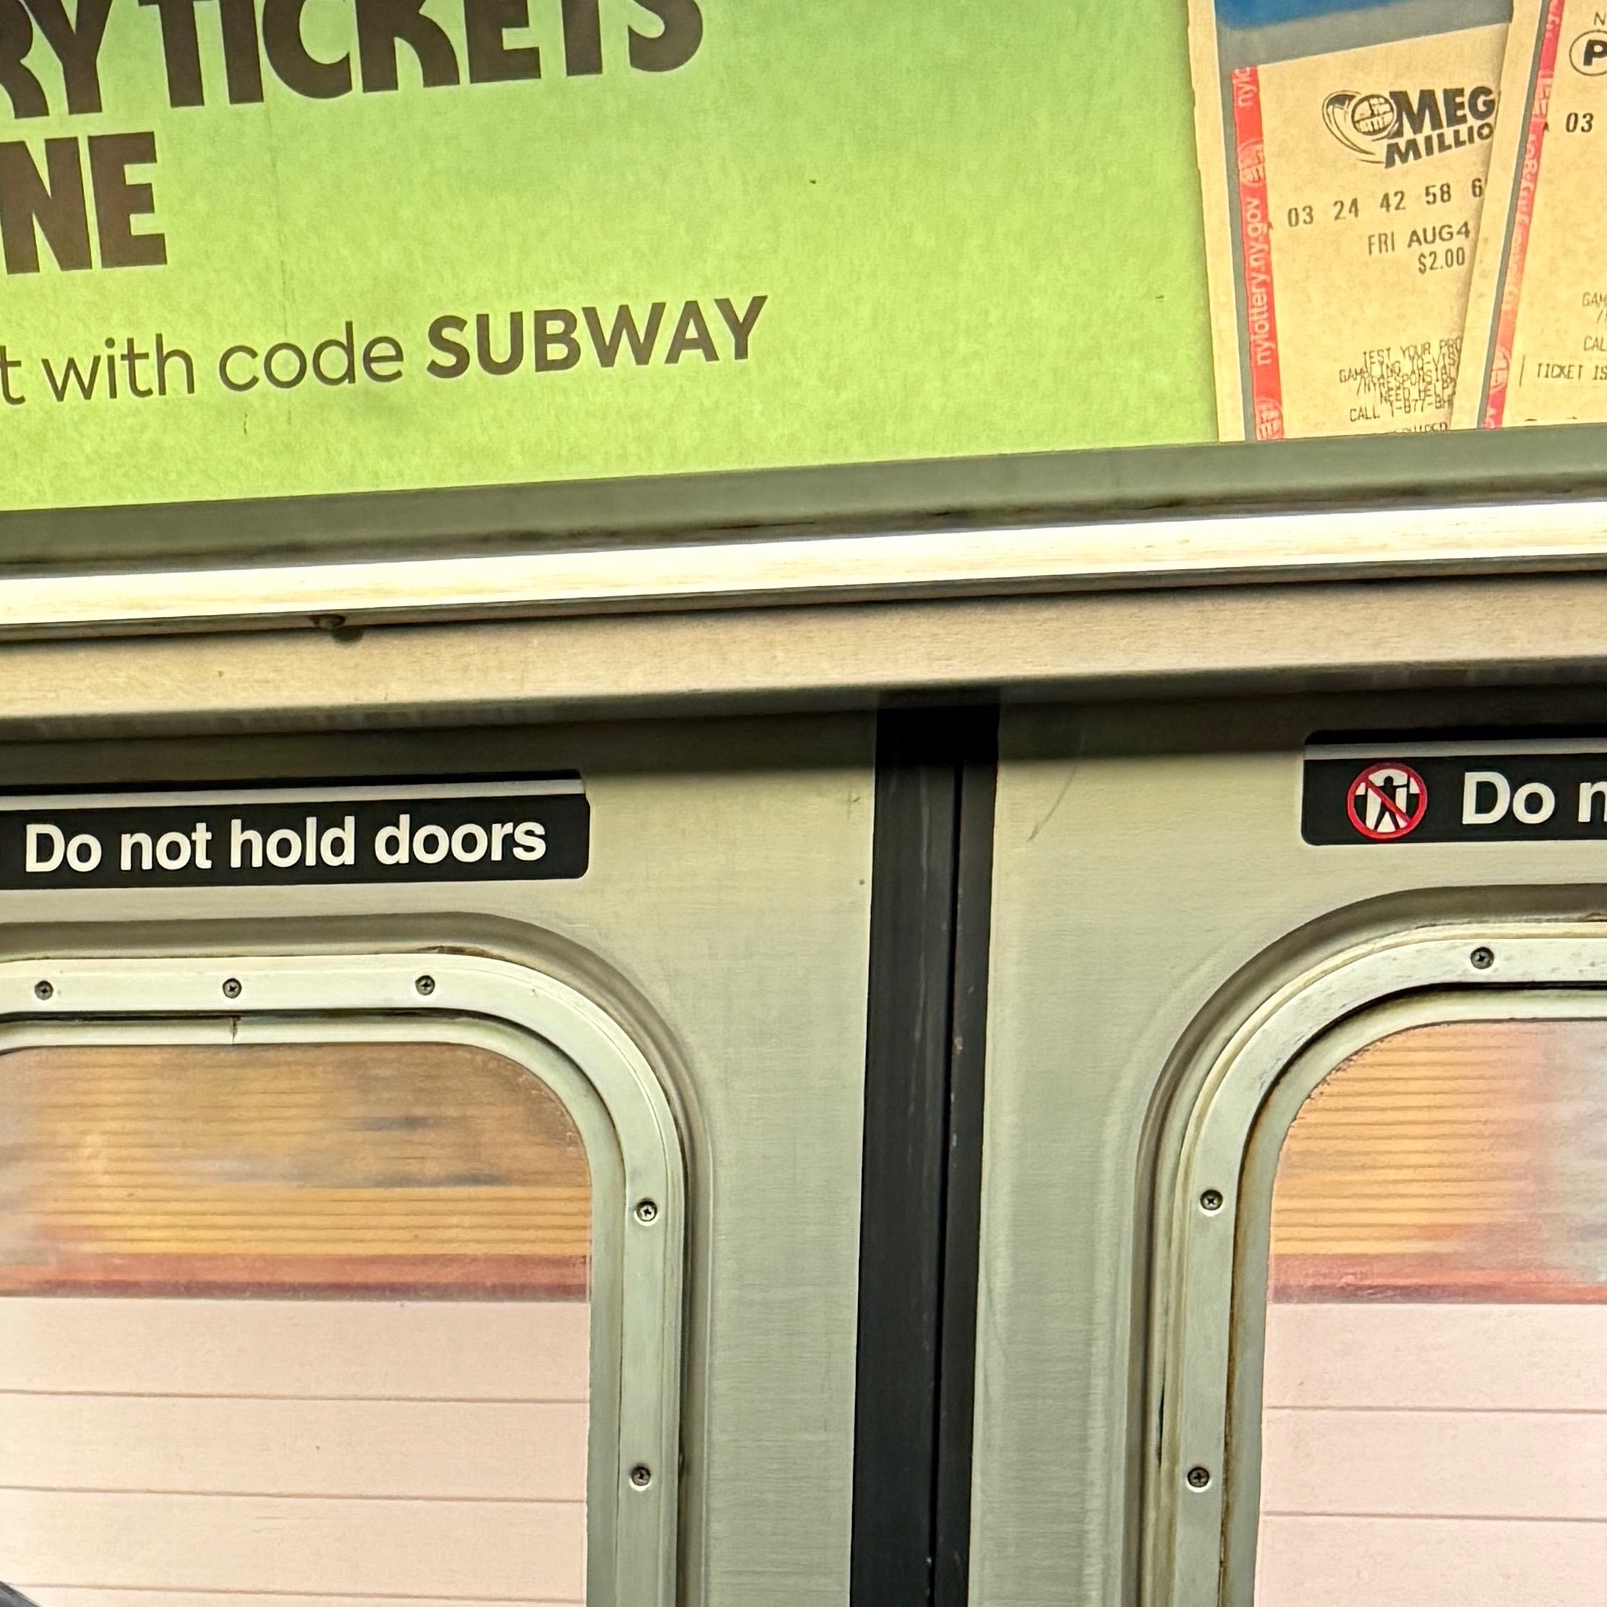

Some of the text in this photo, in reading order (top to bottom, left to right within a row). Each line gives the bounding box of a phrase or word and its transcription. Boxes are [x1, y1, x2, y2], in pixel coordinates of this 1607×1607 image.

[138, 0, 703, 108] TICKETS
[1386, 86, 1495, 140] MEG
[1565, 113, 1594, 133] 03
[1384, 122, 1493, 169] MILLIO
[1287, 205, 1314, 228] 03
[1333, 197, 1360, 221] 24
[1379, 190, 1406, 213] 42
[1425, 182, 1452, 206] 58
[1368, 230, 1395, 256] FRI
[1418, 246, 1466, 274] $2.00
[1245, 197, 1275, 367] nylottery.ny.gov
[42, 334, 194, 402] with
[220, 322, 404, 391] code
[427, 296, 768, 379] SUBWAY
[1462, 771, 1556, 825] Do
[26, 814, 547, 873] Do not hold doors
